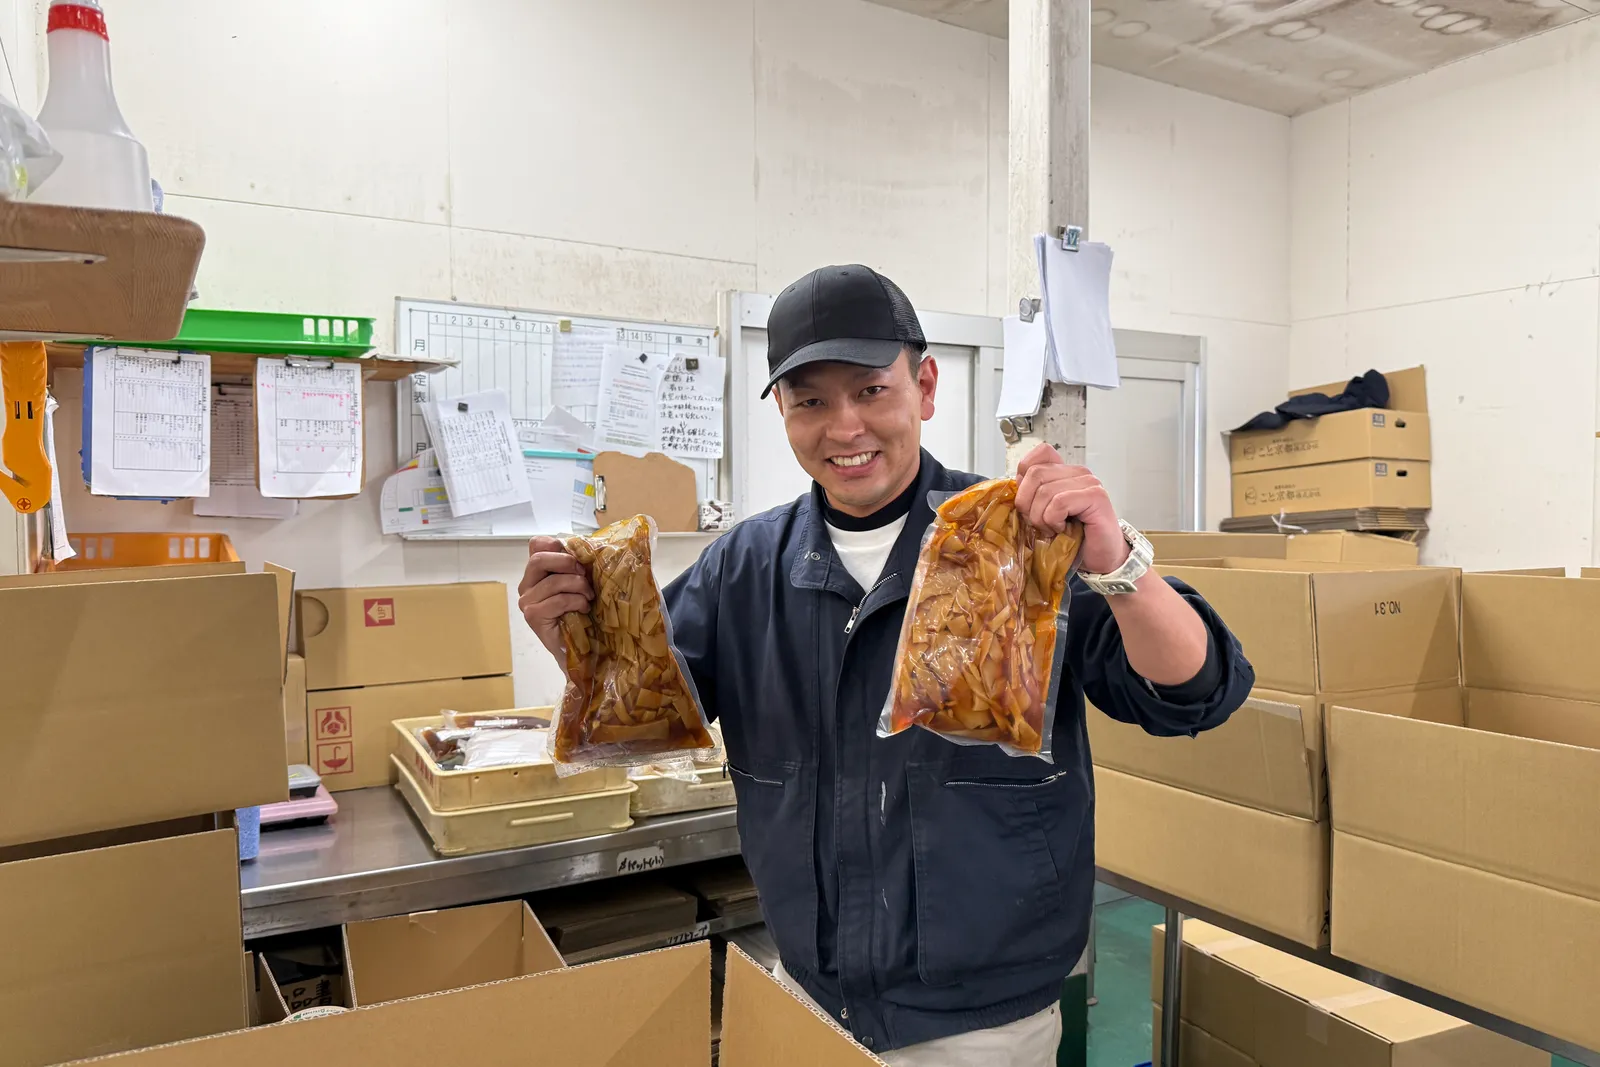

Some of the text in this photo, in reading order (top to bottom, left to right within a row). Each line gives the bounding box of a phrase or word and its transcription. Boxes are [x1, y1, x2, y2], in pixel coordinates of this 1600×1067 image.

[434, 314, 439, 323] 1
[451, 315, 457, 325] 2
[467, 317, 473, 327] 3
[483, 318, 489, 327] 4
[499, 320, 505, 329] 5
[515, 321, 521, 330] 6
[531, 323, 537, 332] 7
[631, 331, 639, 341] 14
[644, 332, 653, 342] 15
[377, 606, 386, 619] UP
[1374, 600, 1401, 616] NO.31
